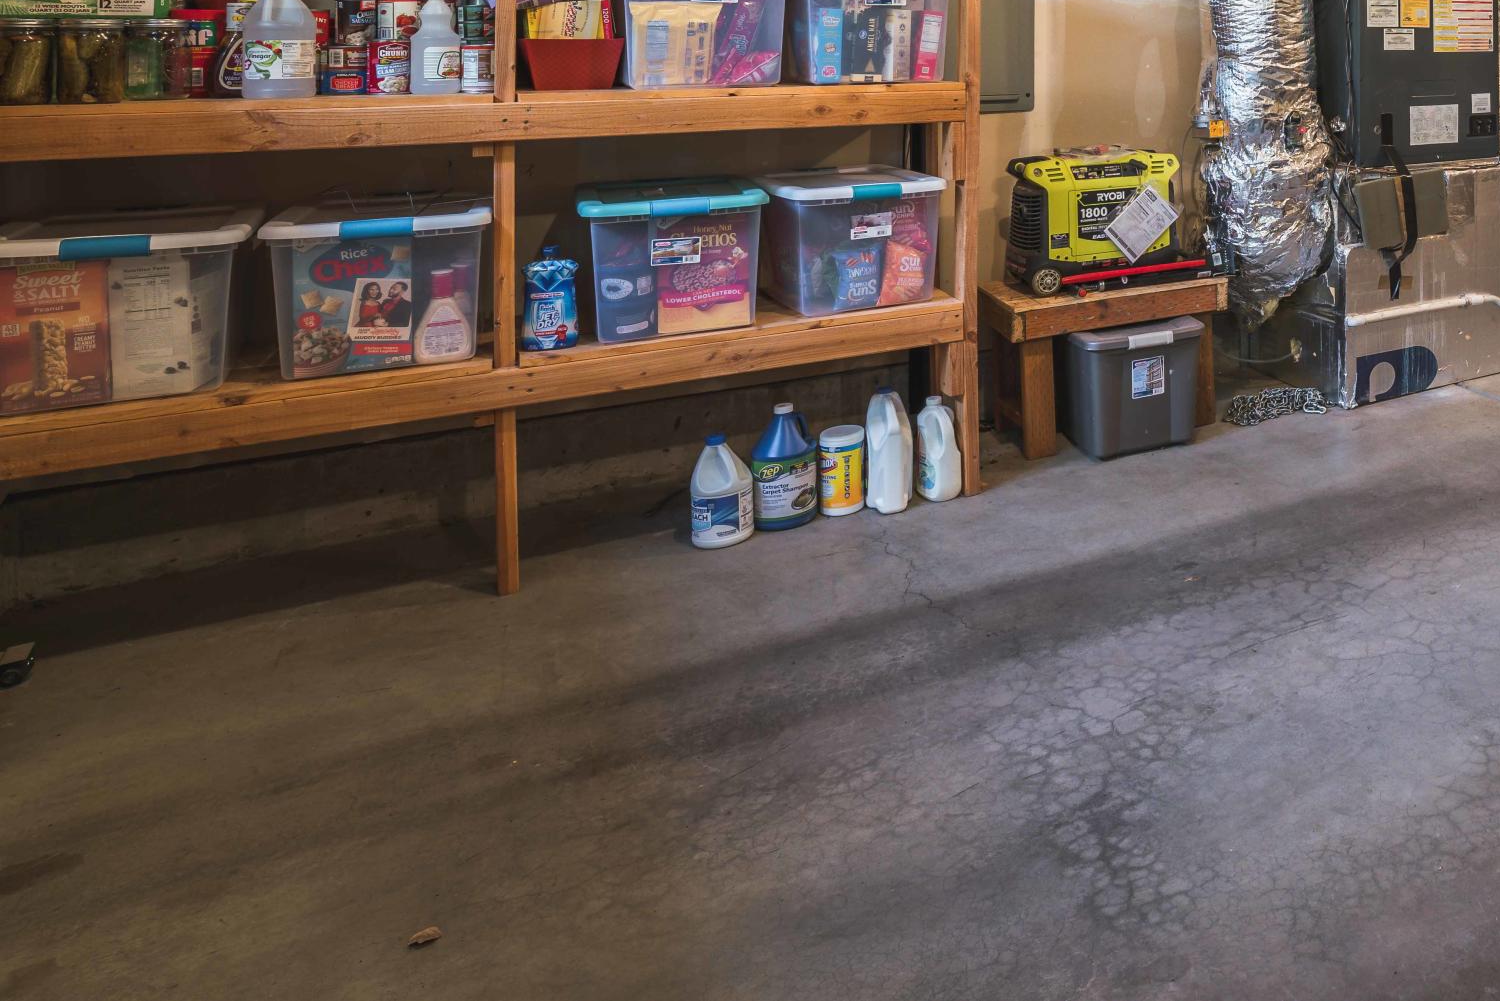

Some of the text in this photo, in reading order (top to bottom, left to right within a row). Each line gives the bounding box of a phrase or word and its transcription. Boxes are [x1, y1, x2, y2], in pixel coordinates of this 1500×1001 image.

[100, 0, 112, 9] 12
[1096, 191, 1125, 202] RYOBI
[1080, 206, 1108, 218] 1800
[718, 223, 732, 231] Nut
[340, 248, 368, 260] Rice
[312, 254, 385, 284] Chex
[13, 271, 86, 289] Sweet
[27, 285, 81, 301] SALTY
[666, 296, 692, 304] LOWER
[693, 289, 742, 301] CHOLESTEROL
[34, 305, 64, 313] Peanut
[536, 318, 559, 330] DRY
